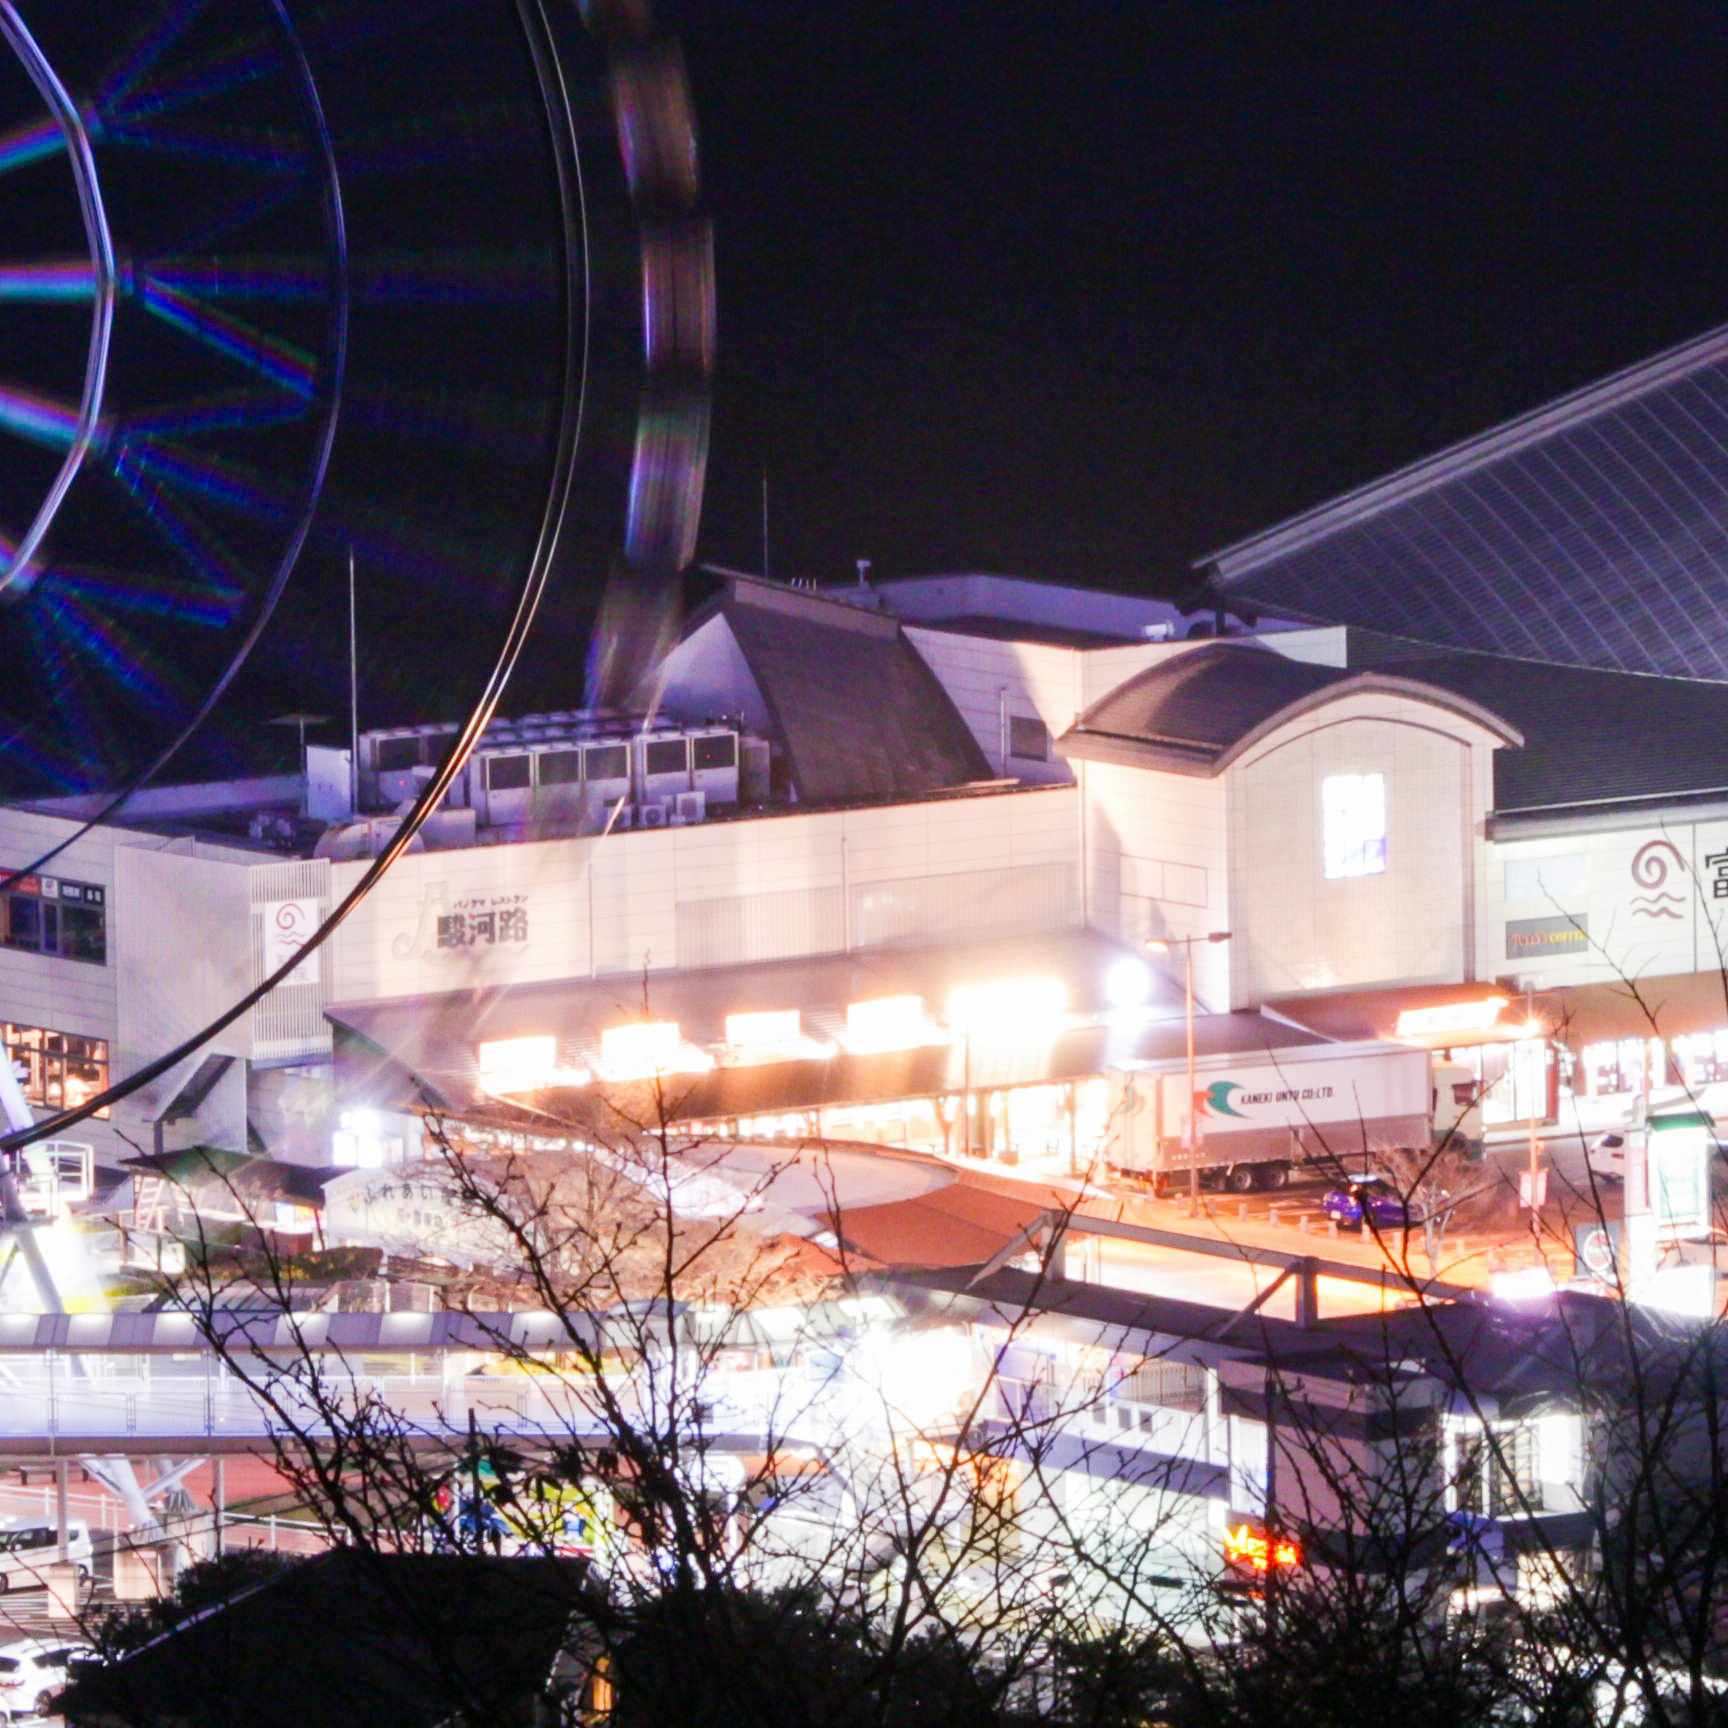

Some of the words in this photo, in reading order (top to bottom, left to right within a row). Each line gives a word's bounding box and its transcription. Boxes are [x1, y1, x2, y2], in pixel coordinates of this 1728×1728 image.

[437, 907, 529, 949] 駿河路
[1240, 1092, 1273, 1105] KANEKI
